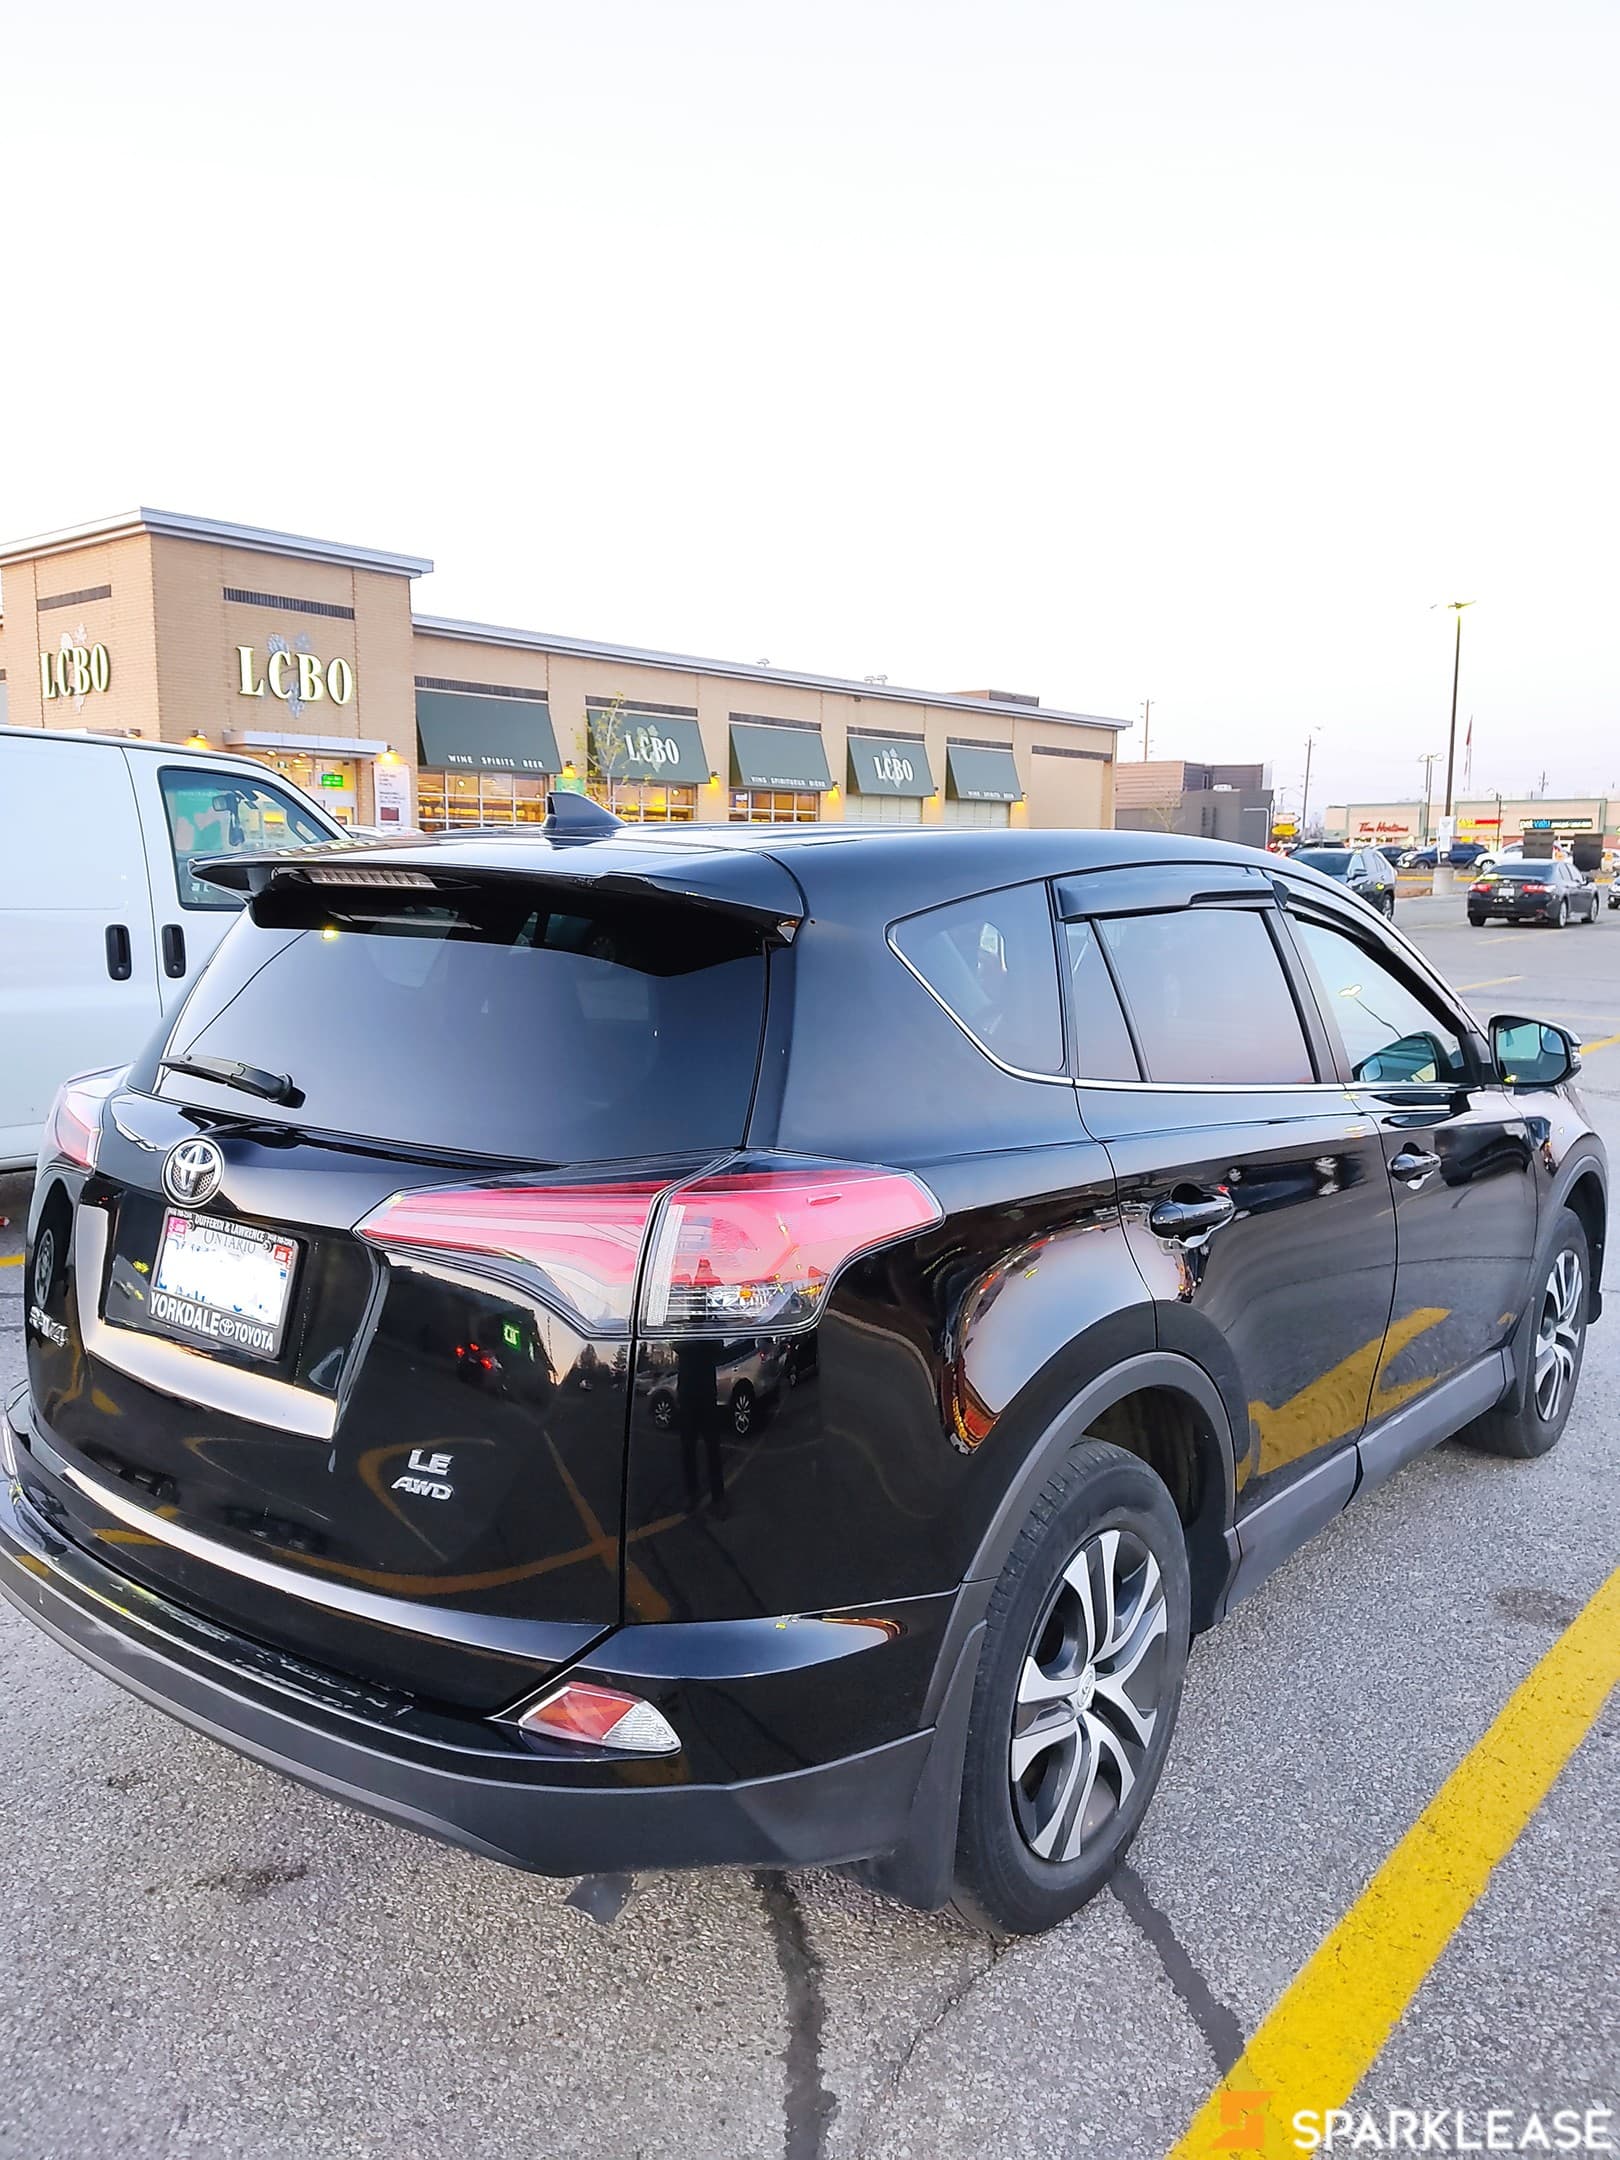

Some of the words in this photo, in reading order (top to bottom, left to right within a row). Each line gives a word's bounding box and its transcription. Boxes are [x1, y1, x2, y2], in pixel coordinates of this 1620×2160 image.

[40, 642, 110, 699] LCBO
[236, 645, 353, 705] LCBO
[448, 754, 473, 764] WINE
[481, 756, 515, 766] SPIRITS
[624, 733, 680, 765] LCBO
[873, 756, 914, 781] LCBO
[150, 1291, 221, 1336] YORKDALE
[234, 1321, 274, 1352] TOYOTA
[408, 1449, 454, 1476] LE
[391, 1476, 454, 1500] AWD
